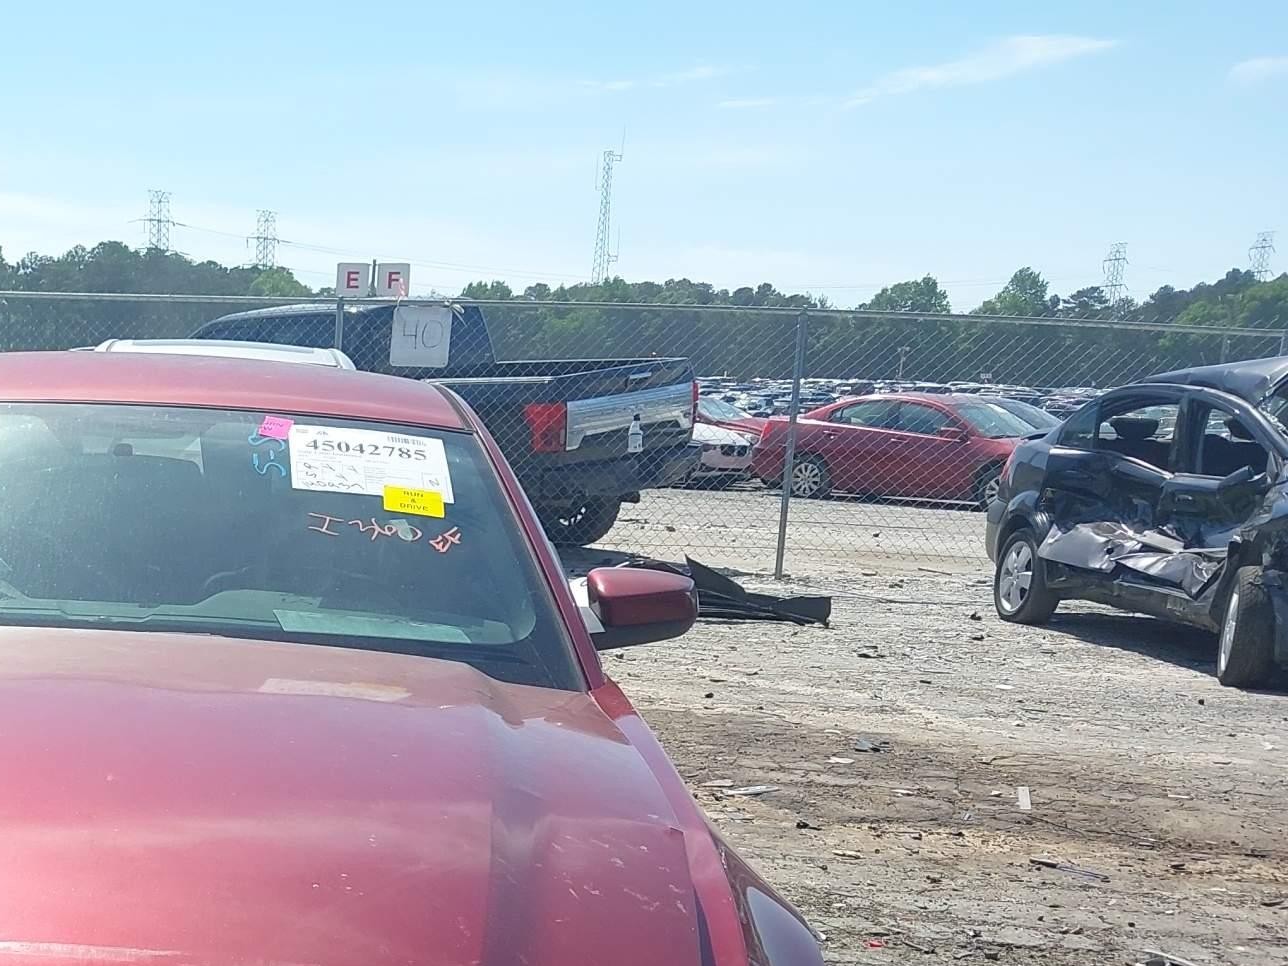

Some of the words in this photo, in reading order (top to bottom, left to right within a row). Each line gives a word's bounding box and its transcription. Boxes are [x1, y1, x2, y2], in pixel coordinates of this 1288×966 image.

[346, 271, 360, 289] E
[387, 271, 401, 289] F
[403, 319, 444, 350] 40
[305, 439, 428, 462] 45042785
[403, 490, 424, 498] RUN
[399, 502, 429, 512] DRIVE
